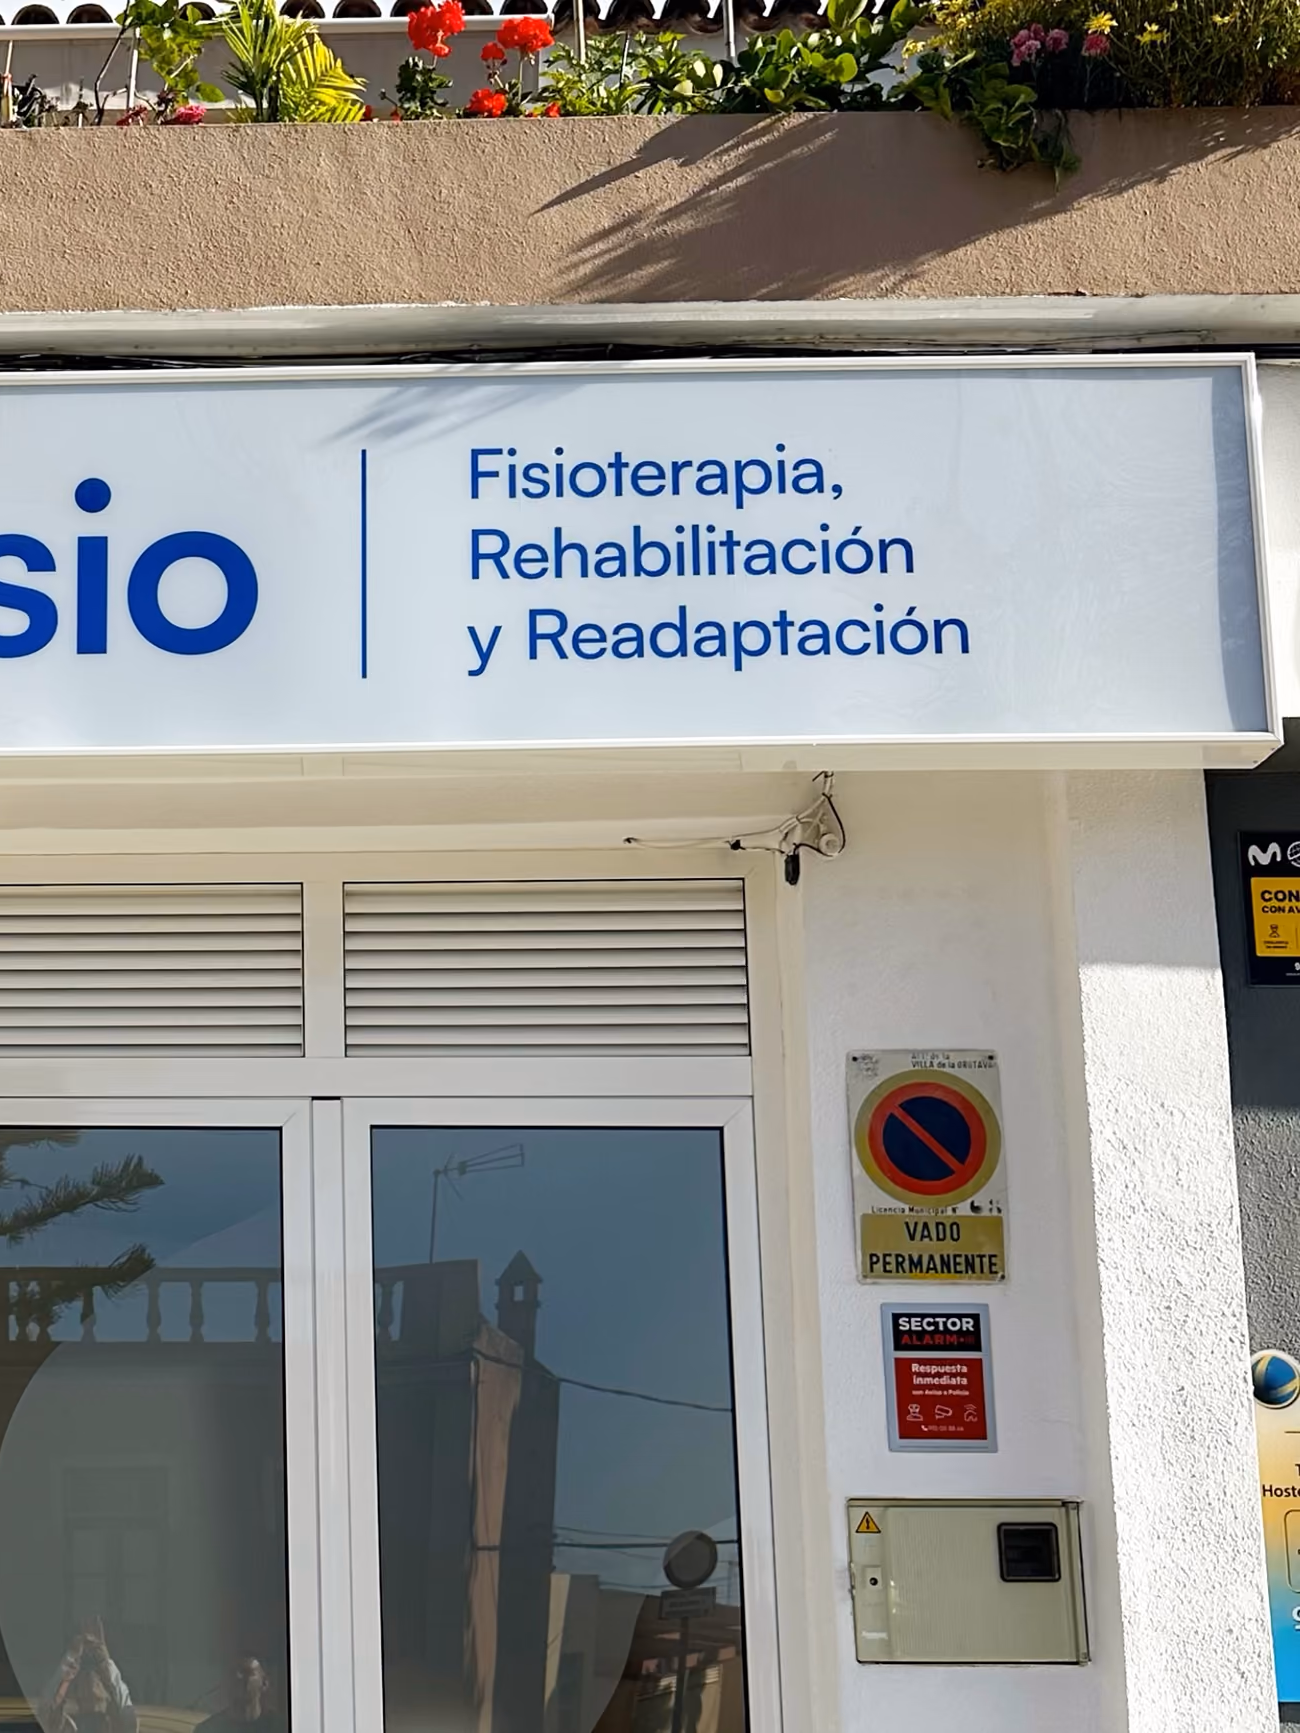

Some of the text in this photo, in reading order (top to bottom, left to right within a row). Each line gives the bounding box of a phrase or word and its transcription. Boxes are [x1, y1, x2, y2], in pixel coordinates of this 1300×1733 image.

[469, 443, 843, 509] Fisioterapia,
[470, 523, 915, 580] Rehabilitación
[467, 603, 970, 677] y Readaptación
[1262, 905, 1286, 914] CON
[905, 1221, 960, 1242] VADO
[869, 1253, 998, 1275] PERMANENTE
[898, 1317, 974, 1331] SECTOR
[901, 1334, 957, 1345] ALARM
[911, 1363, 968, 1375] Respuesta
